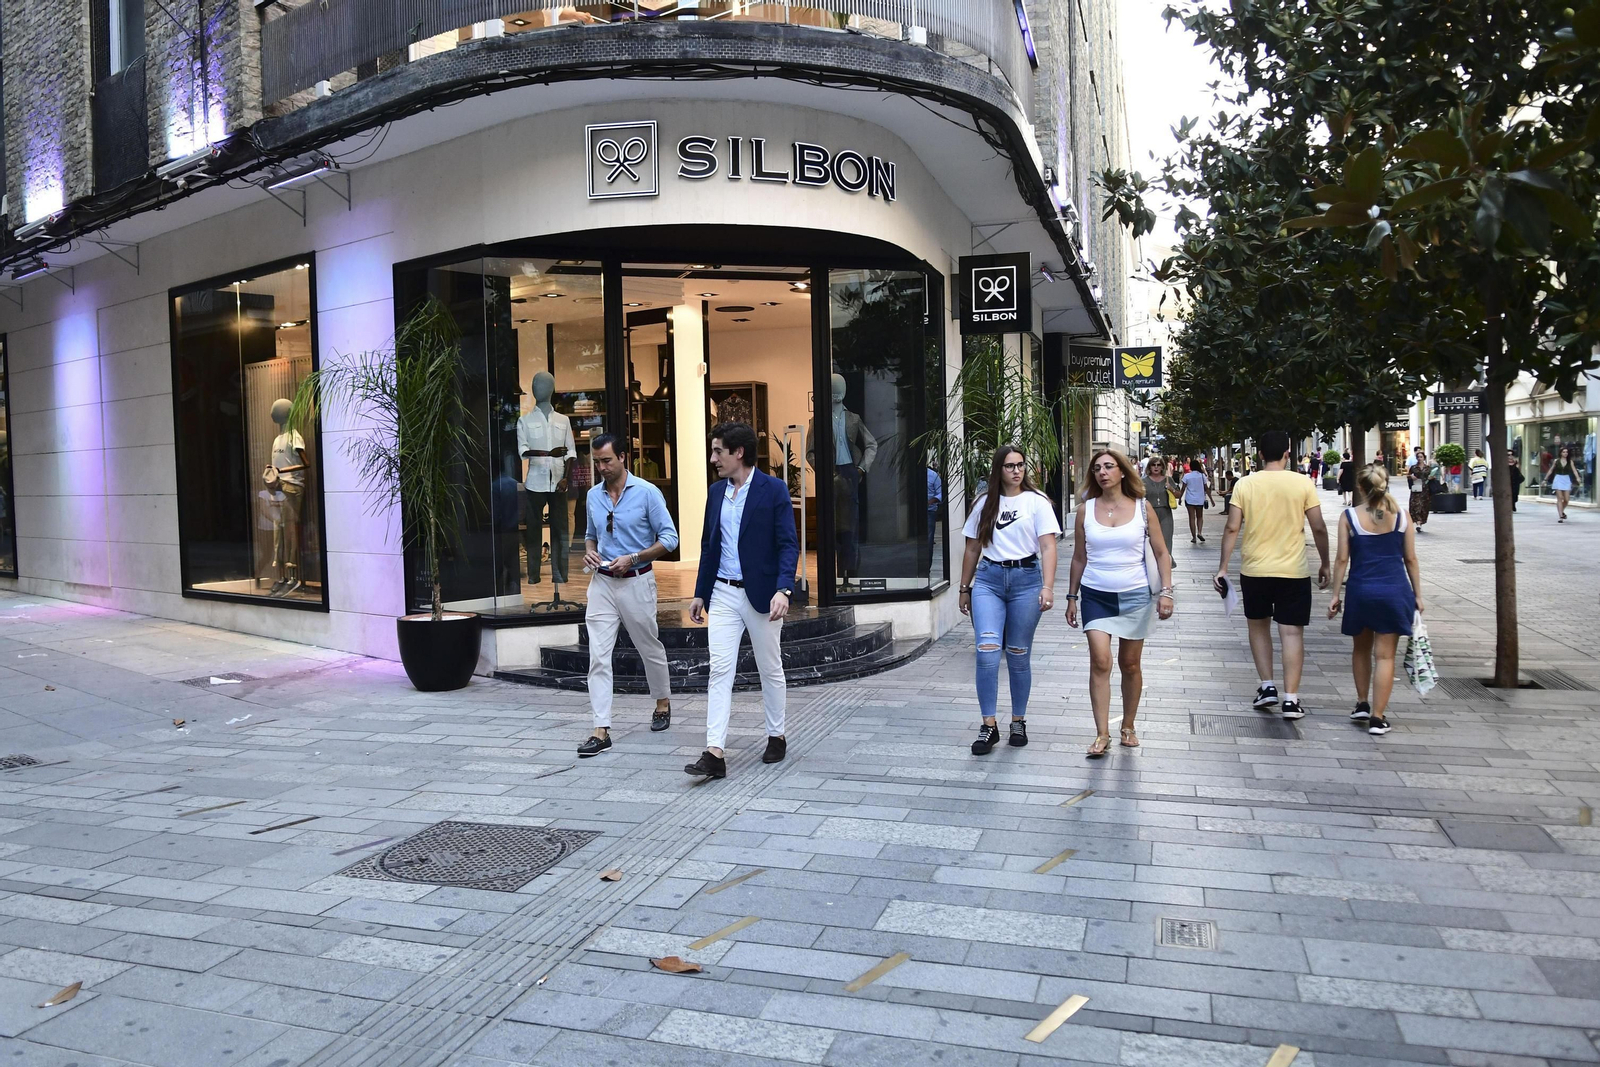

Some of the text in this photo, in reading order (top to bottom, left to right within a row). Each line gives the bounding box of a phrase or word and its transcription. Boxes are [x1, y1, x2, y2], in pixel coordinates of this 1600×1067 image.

[676, 135, 897, 201] SILBON
[972, 312, 1017, 322] SILBON
[1071, 353, 1112, 367] buypremium
[1086, 369, 1112, 384] outlet
[1438, 396, 1479, 405] LUQUE
